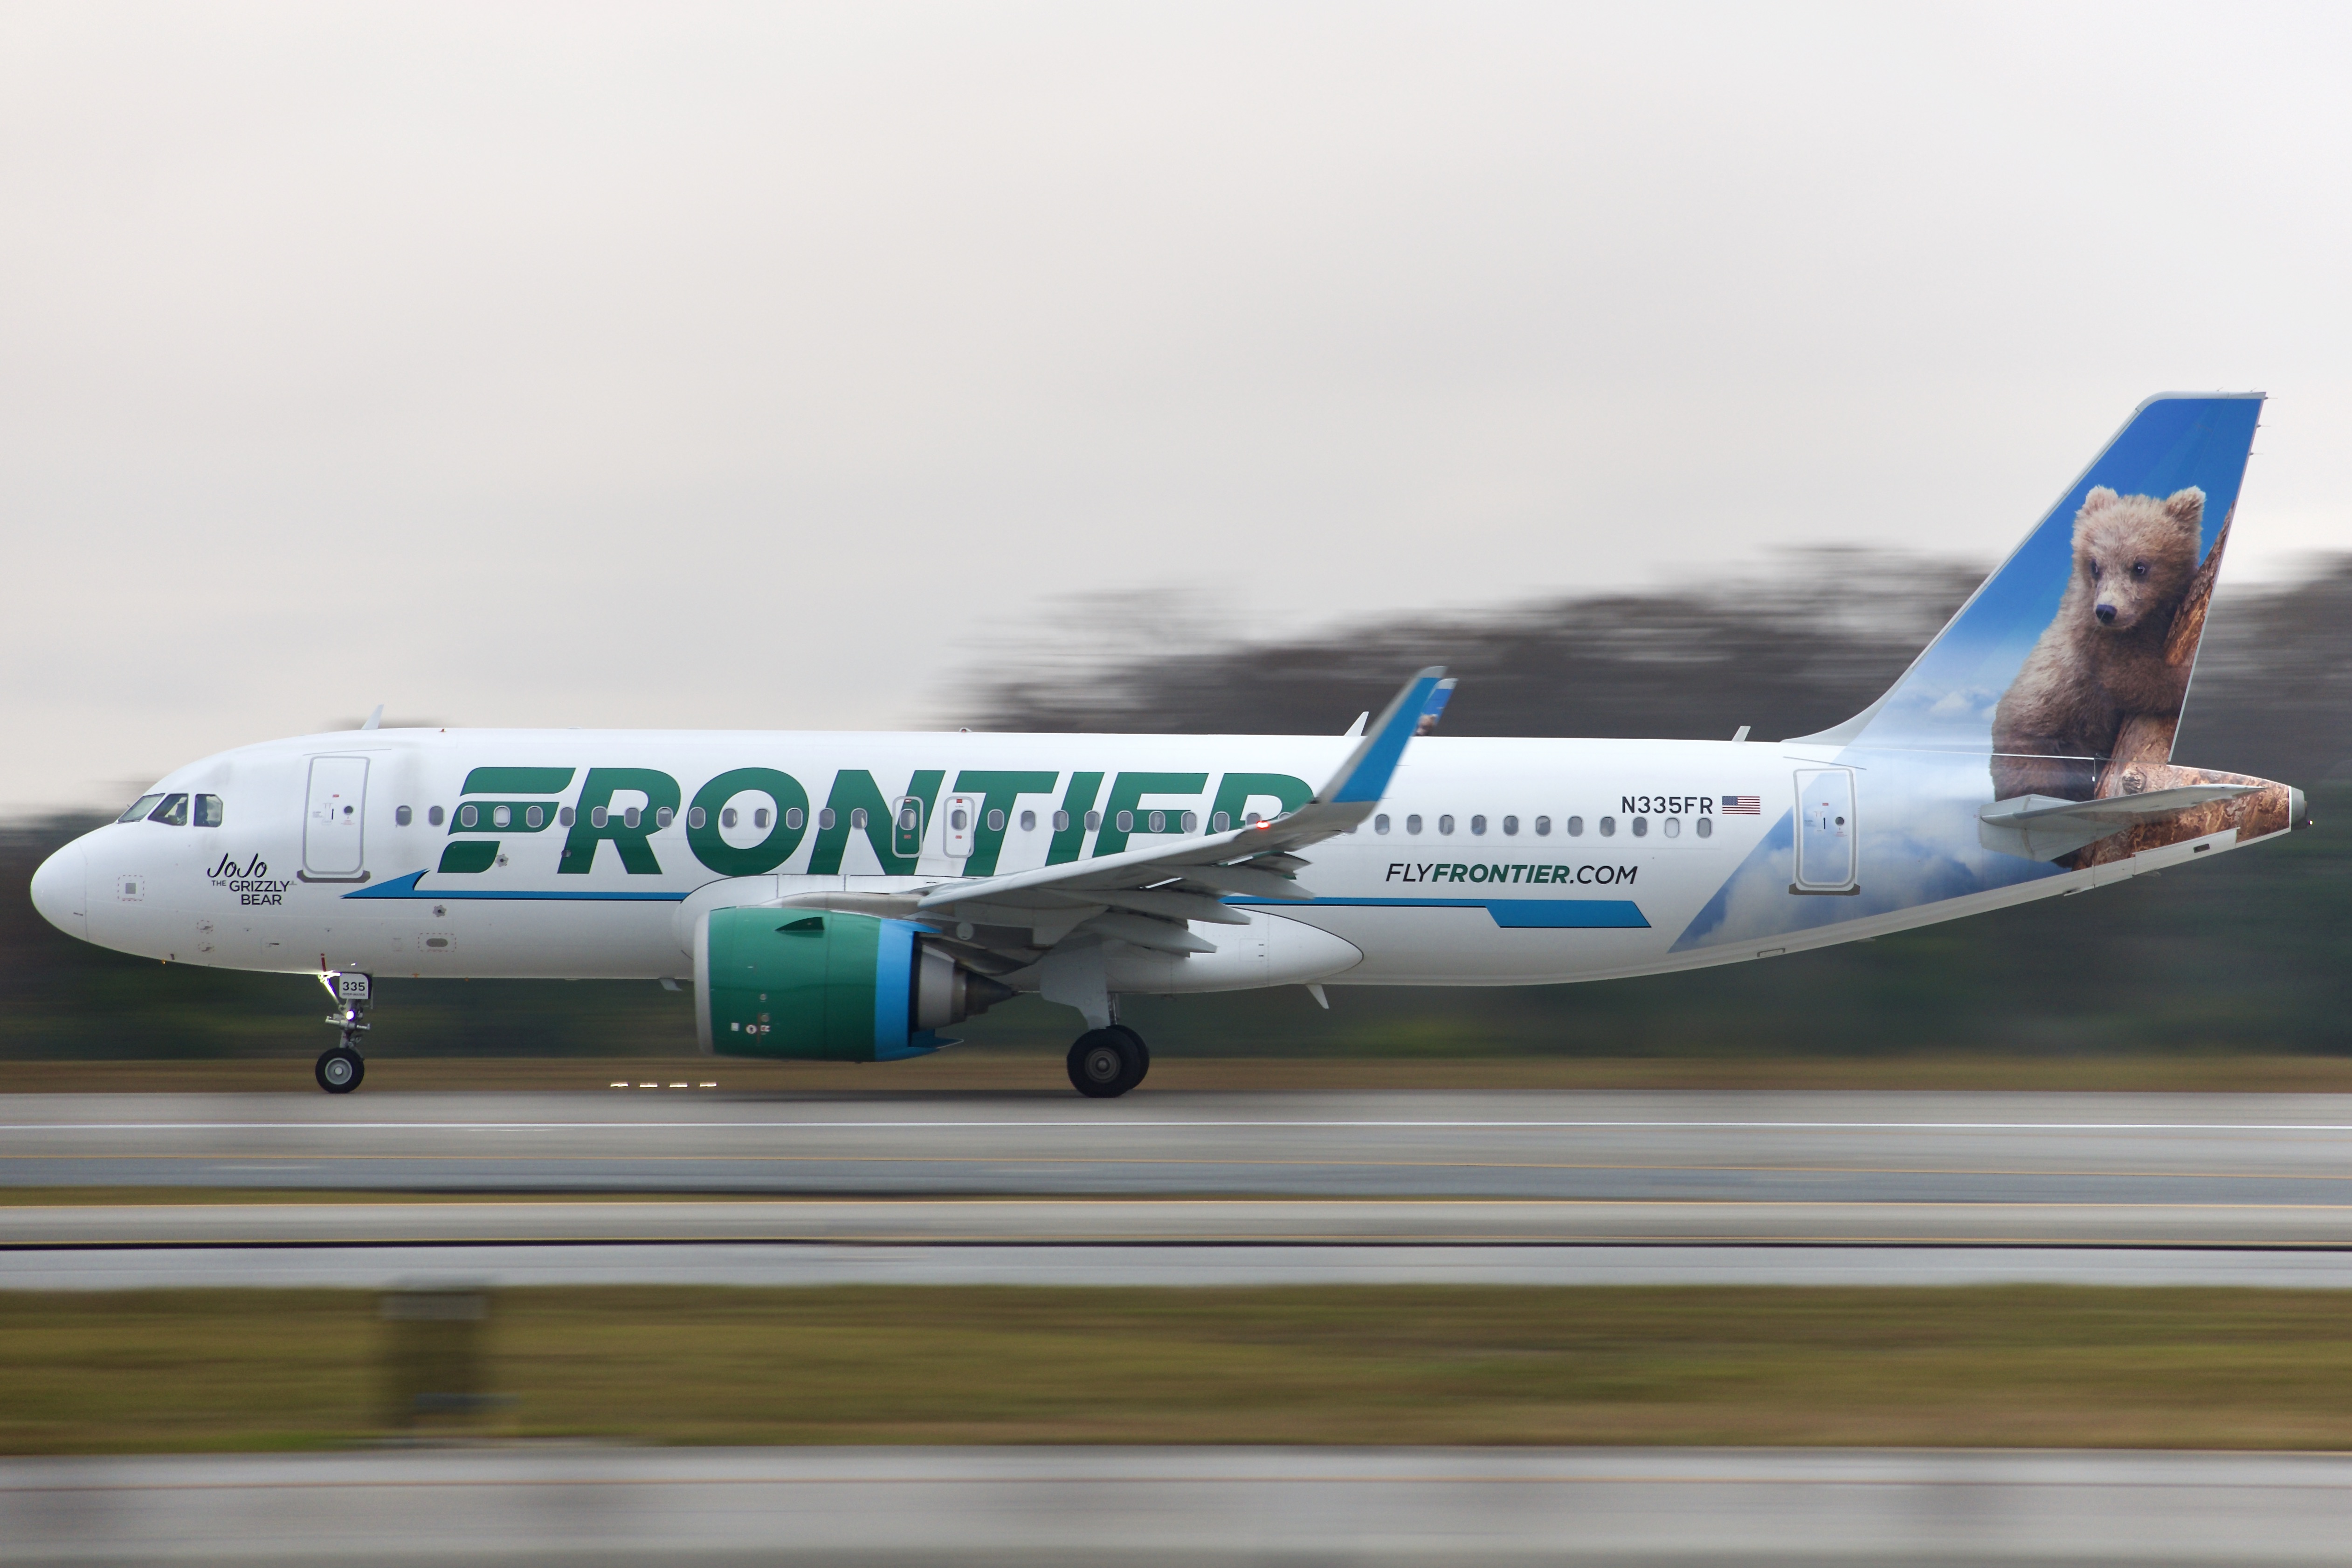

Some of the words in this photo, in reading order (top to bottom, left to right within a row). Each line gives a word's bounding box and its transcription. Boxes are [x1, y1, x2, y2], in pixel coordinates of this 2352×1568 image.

[1622, 796, 1713, 814] N335FR
[207, 853, 267, 878] JoJo
[1386, 863, 1638, 885] FLYFRONTIER.COM
[229, 880, 290, 892] GRIZZLY
[241, 894, 282, 905] BEAR
[343, 982, 365, 991] 335
